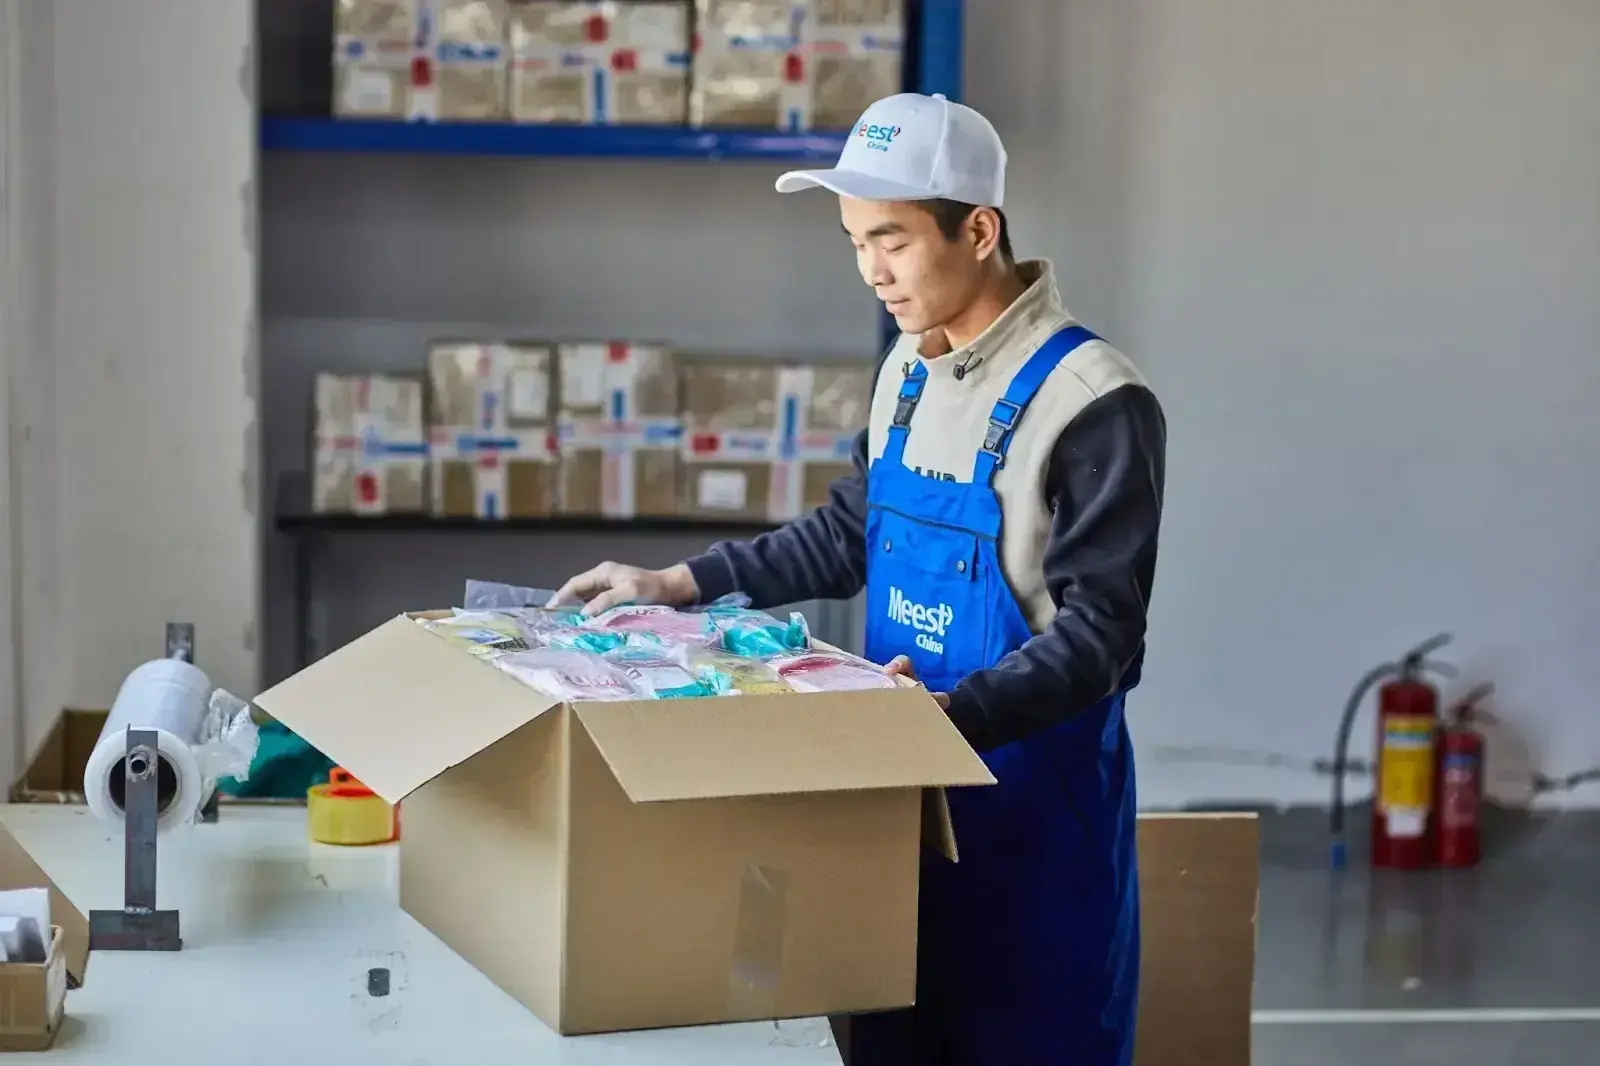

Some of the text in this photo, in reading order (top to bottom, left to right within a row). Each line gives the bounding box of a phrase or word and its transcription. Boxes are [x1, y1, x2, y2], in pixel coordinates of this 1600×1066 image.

[867, 141, 888, 152] China
[888, 586, 949, 637] Meest
[915, 633, 944, 655] China
